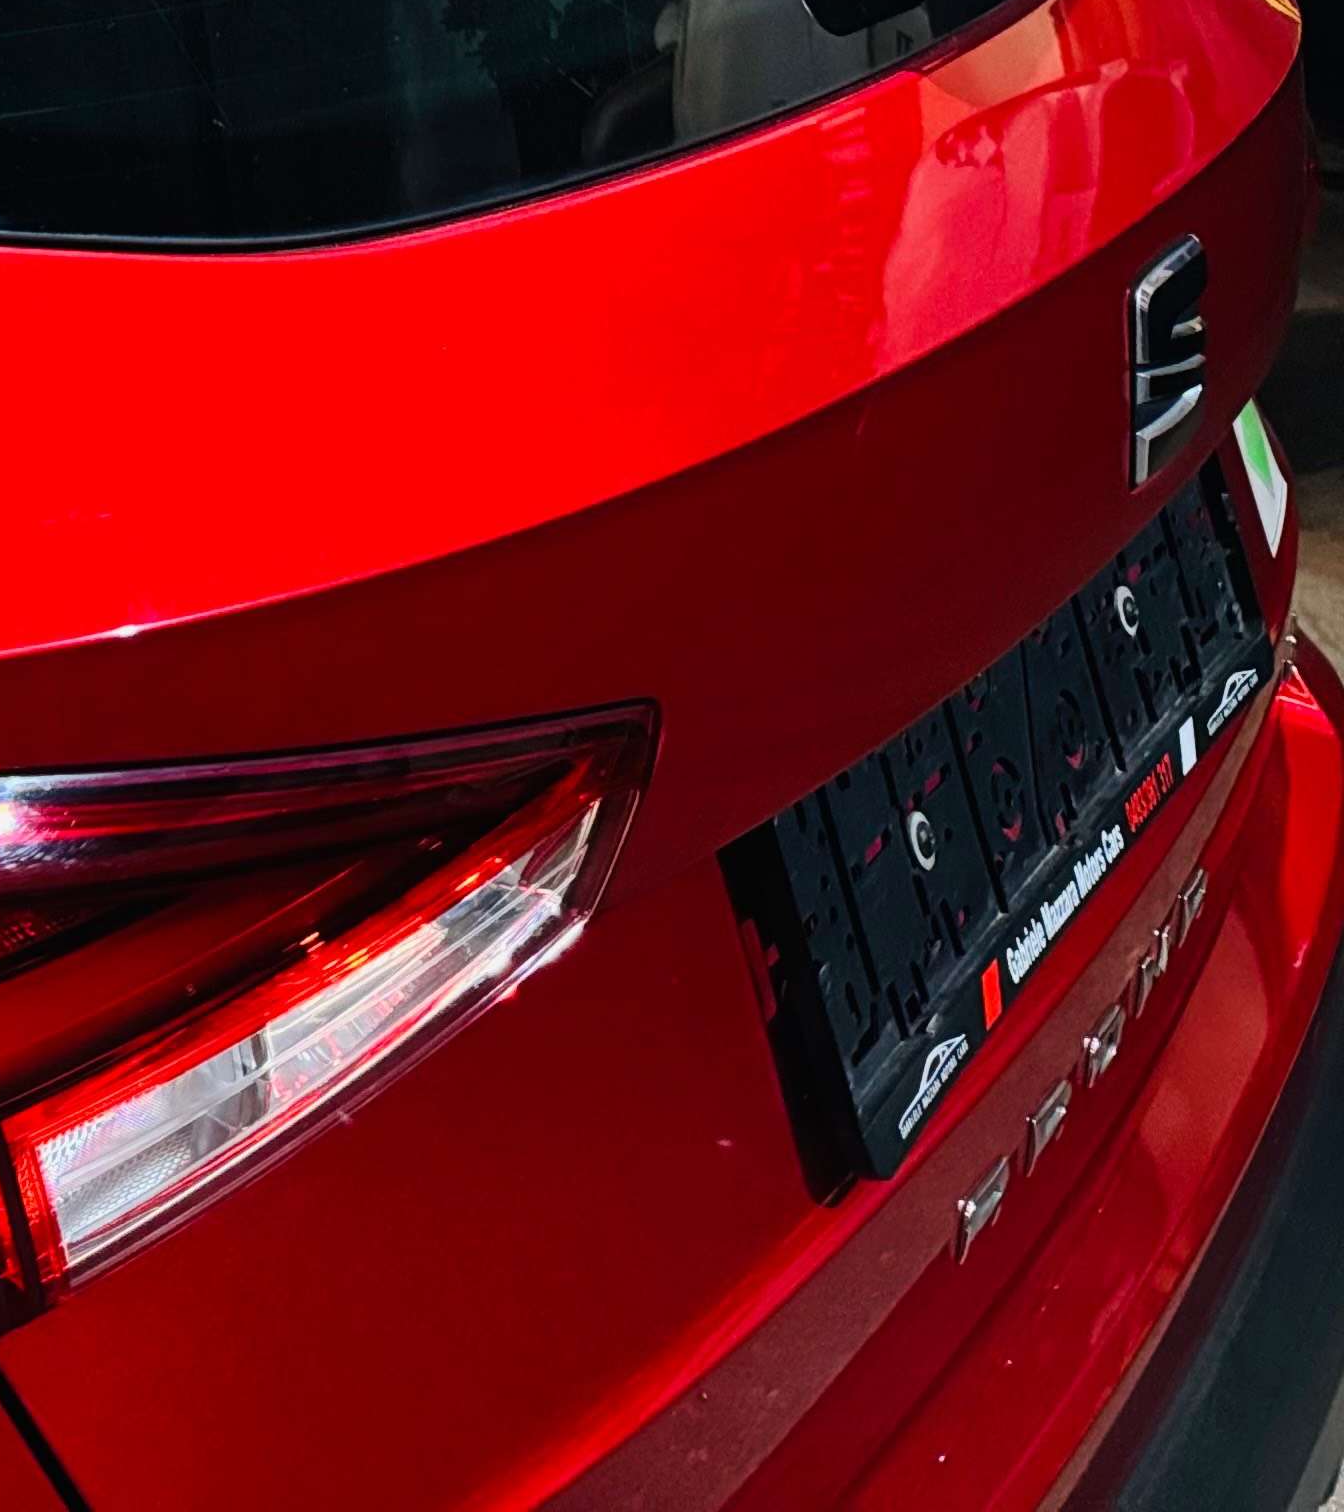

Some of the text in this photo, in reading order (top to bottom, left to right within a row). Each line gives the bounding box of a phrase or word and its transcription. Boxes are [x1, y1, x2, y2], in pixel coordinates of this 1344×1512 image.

[1006, 918, 1047, 984] Gabriele
[1040, 880, 1080, 941] Mazzara
[1073, 853, 1107, 900] Motors
[1100, 824, 1125, 864] Cars
